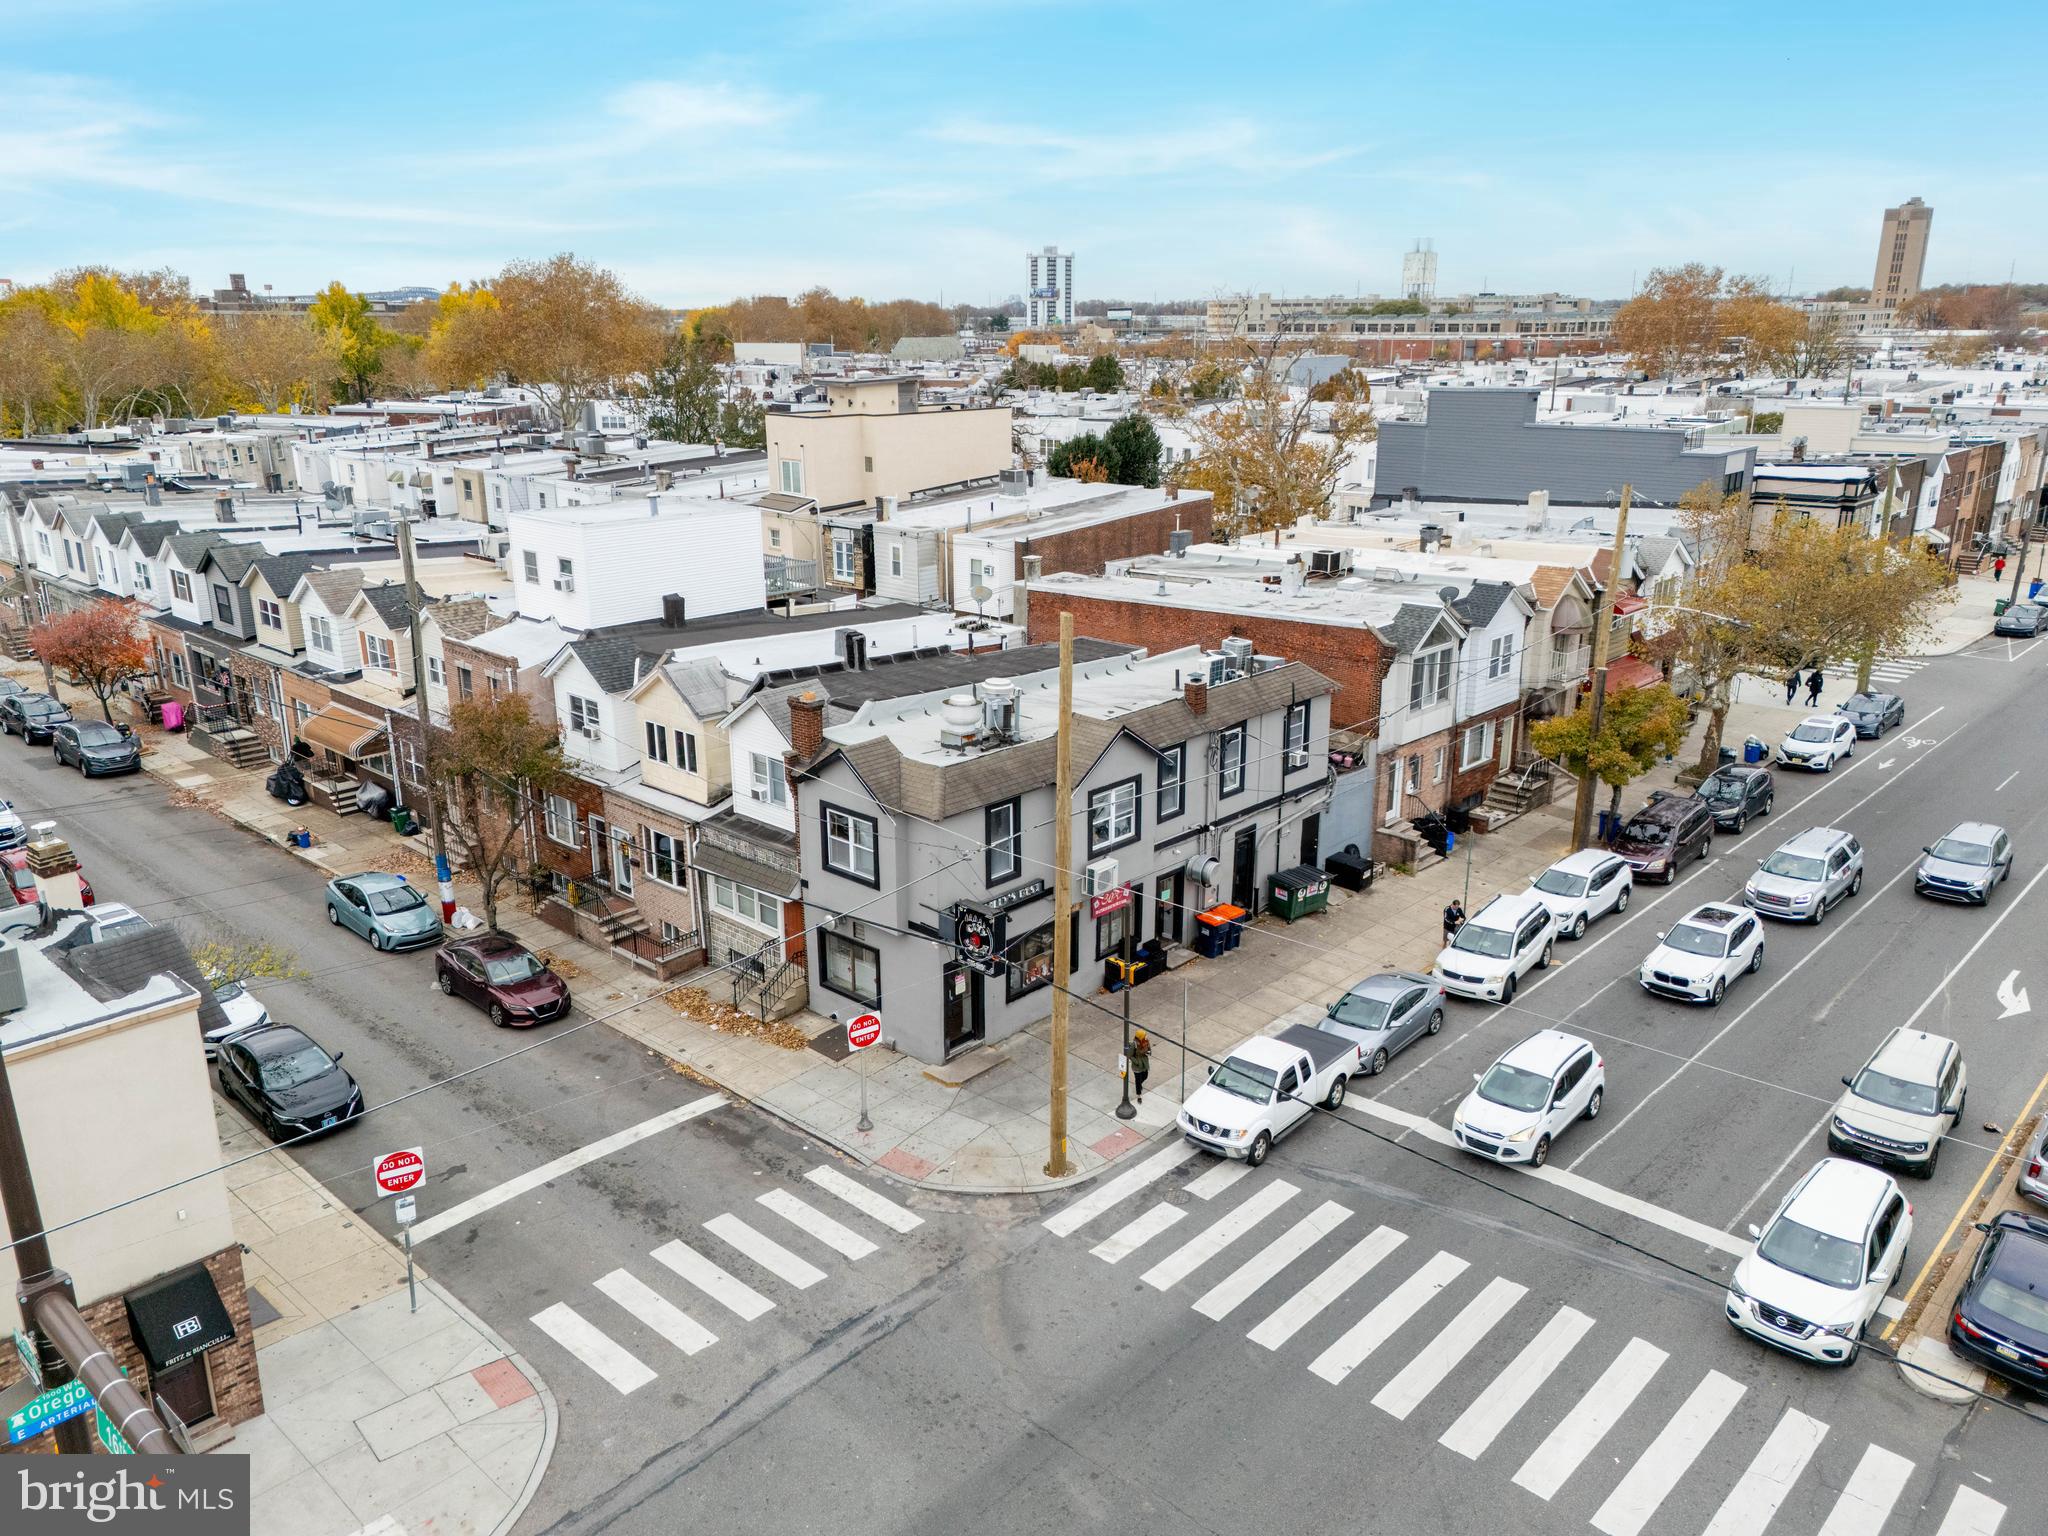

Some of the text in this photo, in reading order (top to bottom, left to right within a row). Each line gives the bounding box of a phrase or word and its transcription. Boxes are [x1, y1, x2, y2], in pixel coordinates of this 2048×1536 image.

[863, 1018, 876, 1027] NOT
[856, 1033, 875, 1044] ENTER
[382, 1156, 416, 1170] DO NOT
[387, 1174, 415, 1187] ENTER
[176, 1319, 198, 1337] FB
[165, 1354, 185, 1367] FRITZ
[185, 1350, 192, 1358] &
[63, 1383, 73, 1392] W
[28, 1386, 86, 1419] Orego
[17, 1428, 26, 1440] E
